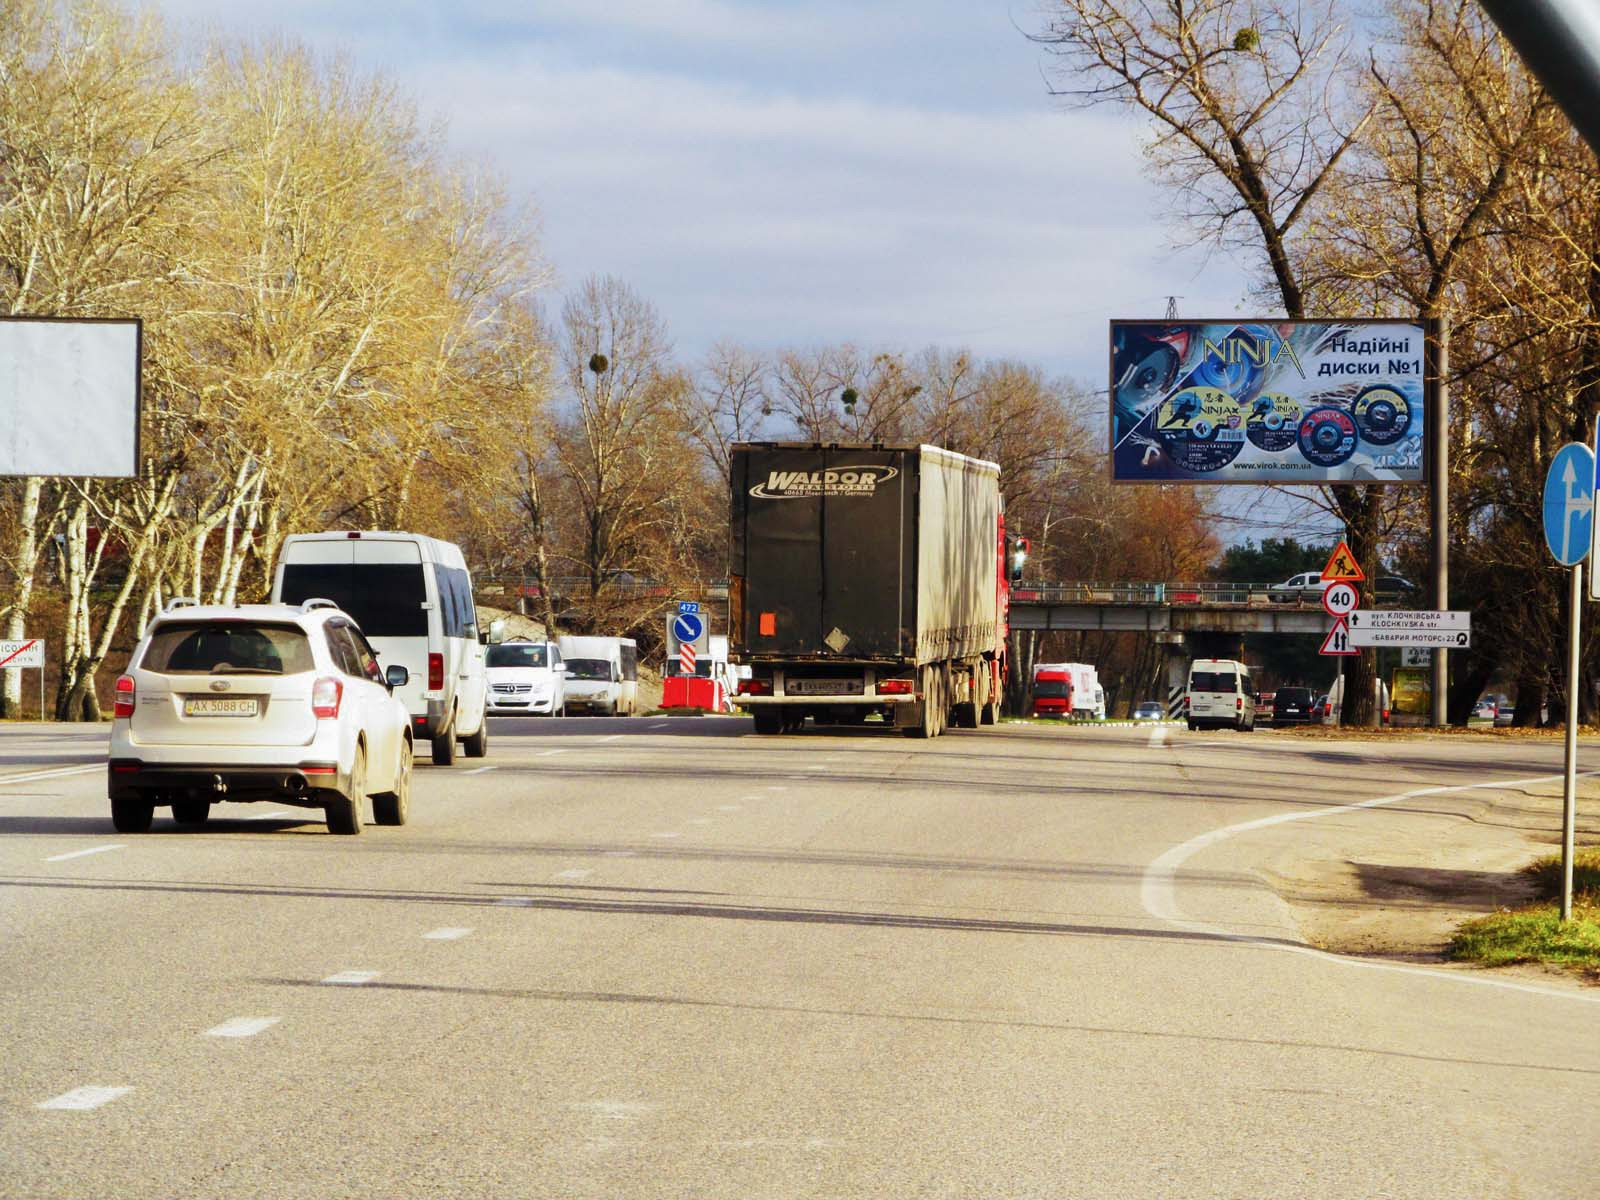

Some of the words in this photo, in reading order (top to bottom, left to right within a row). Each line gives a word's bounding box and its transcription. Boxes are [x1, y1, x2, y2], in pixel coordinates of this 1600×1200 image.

[1332, 337, 1410, 356] Надійні
[1202, 338, 1306, 379] NINJA
[1318, 361, 1380, 376] диски
[1388, 360, 1420, 375] №1
[1233, 462, 1312, 470] www.virok.com.ua
[767, 471, 877, 490] WALDOR
[1331, 592, 1350, 606] 40
[680, 603, 697, 612] 472
[1387, 612, 1441, 620] КЛОЧКІВСЬКА
[193, 702, 208, 712] AX
[211, 702, 236, 712] 5088
[239, 702, 255, 713] CH
